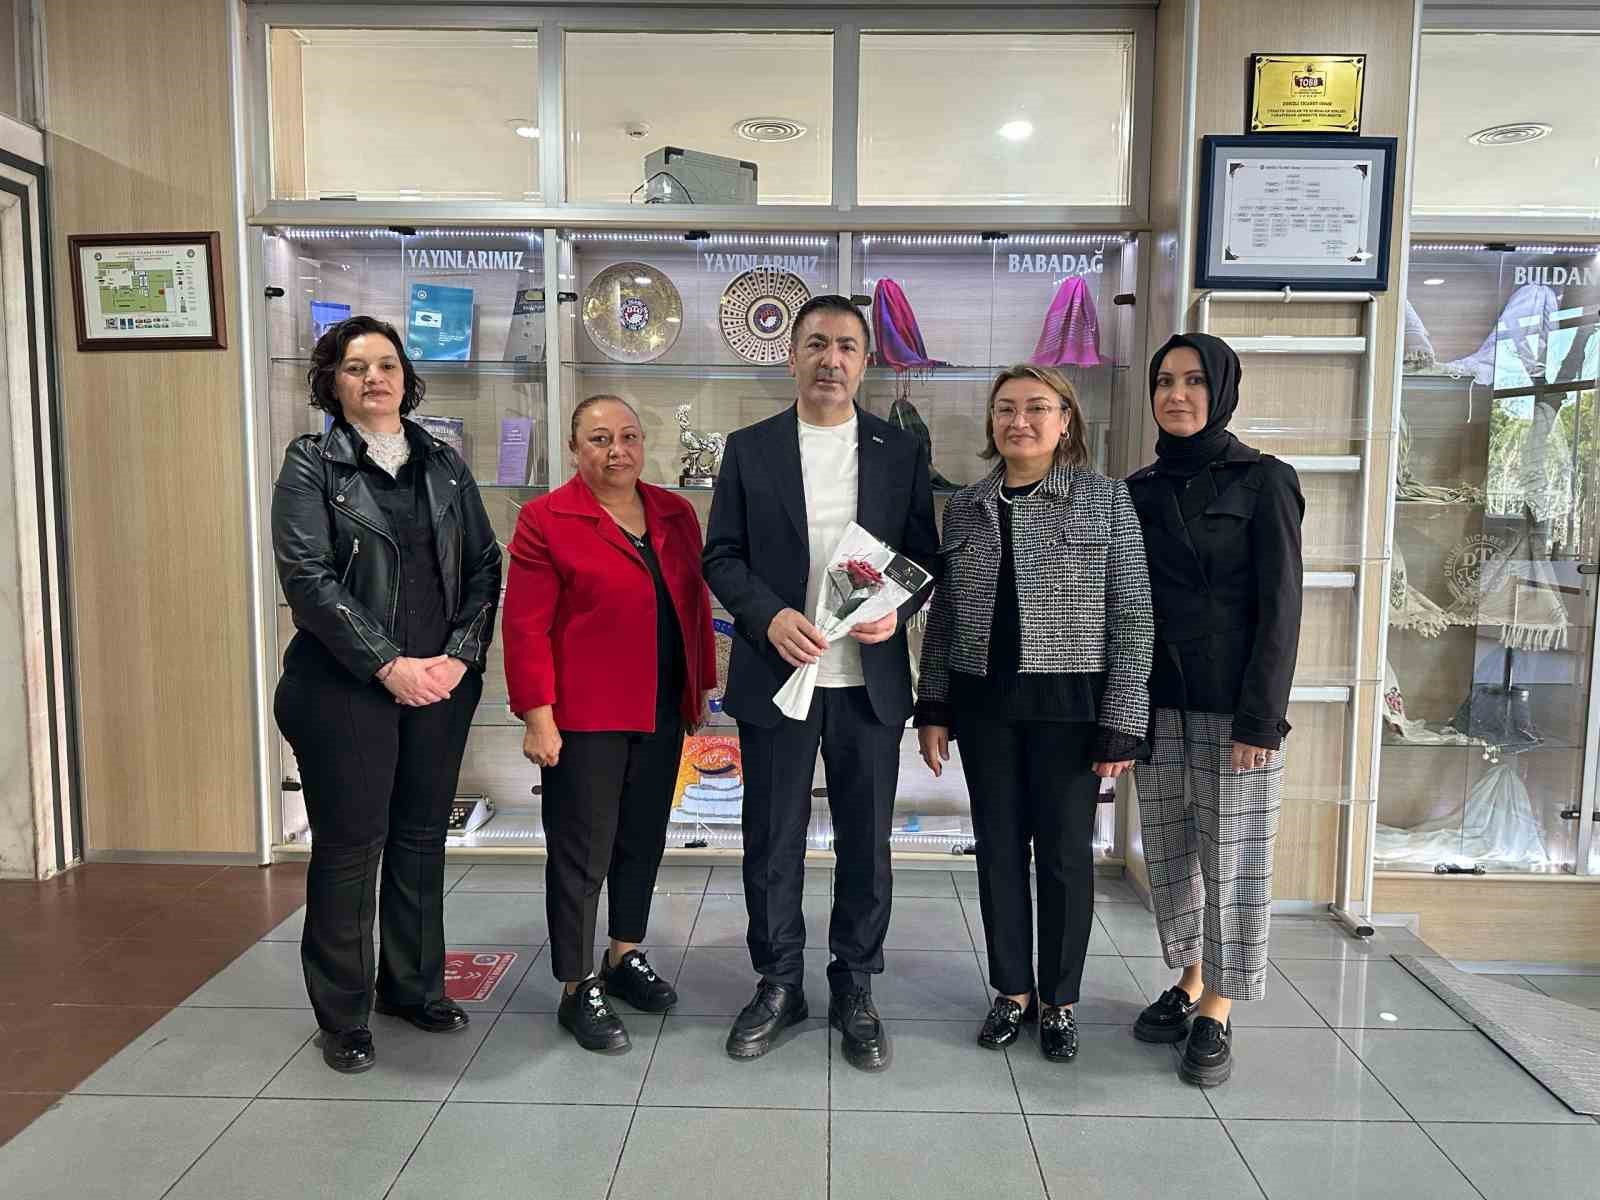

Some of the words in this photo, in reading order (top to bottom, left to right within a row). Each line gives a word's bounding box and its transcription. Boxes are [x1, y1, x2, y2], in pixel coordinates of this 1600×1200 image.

[408, 249, 524, 270] YAYINLARIMIZ
[703, 253, 818, 273] YAYINLARIMIZ
[1008, 249, 1104, 273] BABADAĞ
